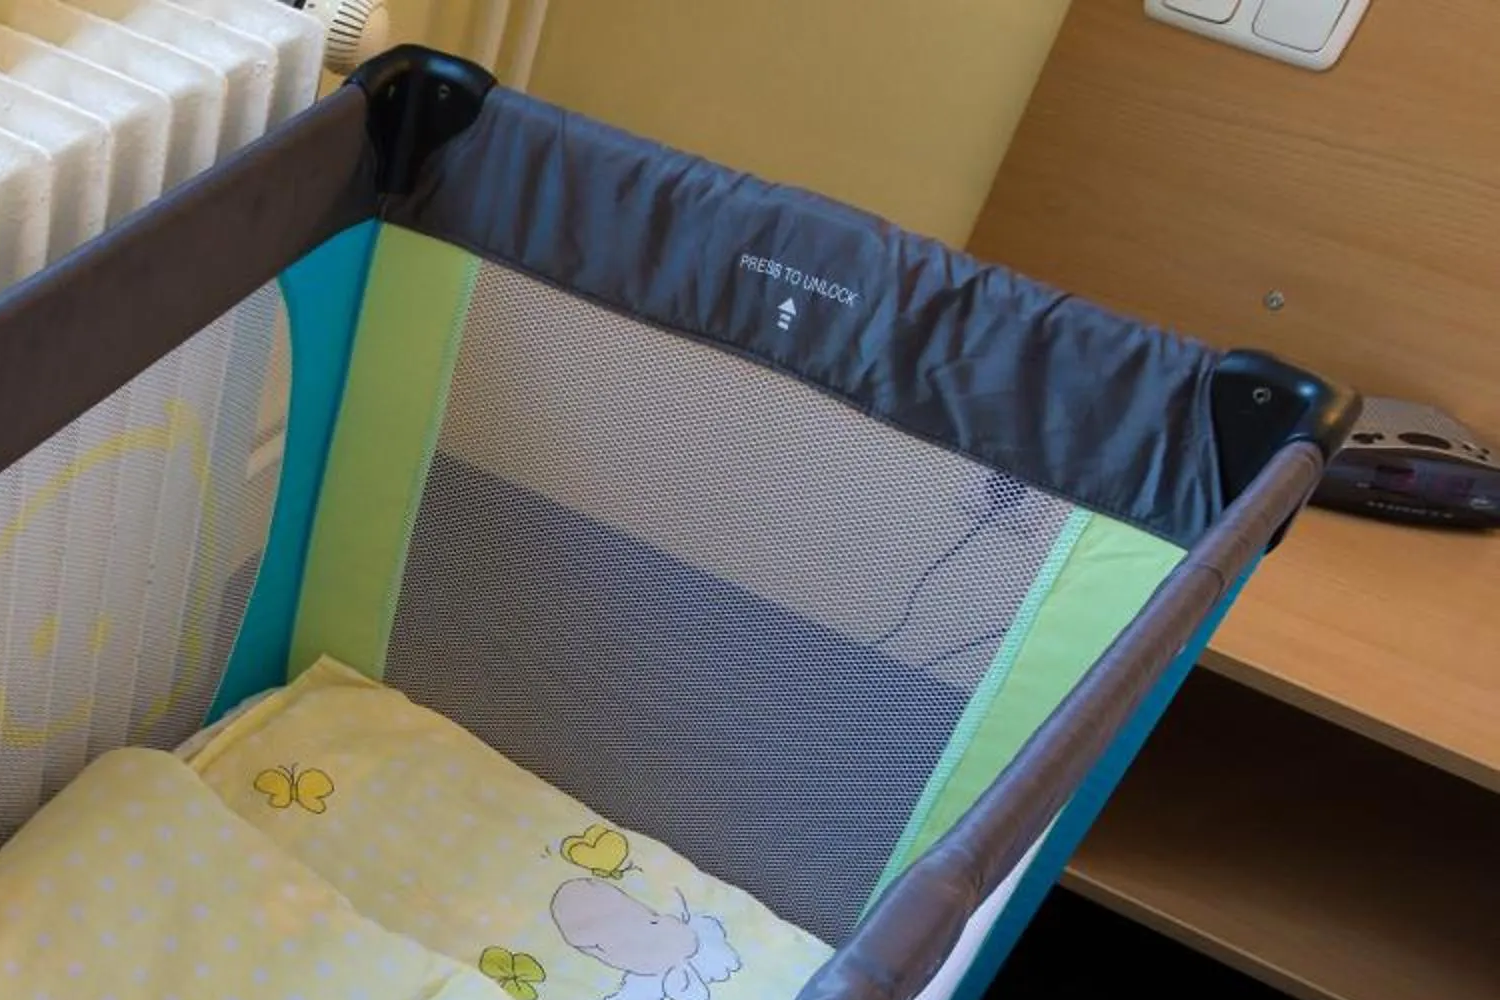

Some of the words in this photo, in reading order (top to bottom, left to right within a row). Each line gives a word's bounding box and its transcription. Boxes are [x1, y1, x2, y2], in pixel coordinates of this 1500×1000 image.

[740, 253, 783, 280] PRESS
[784, 266, 802, 285] TO
[803, 274, 858, 307] UNLOCK
